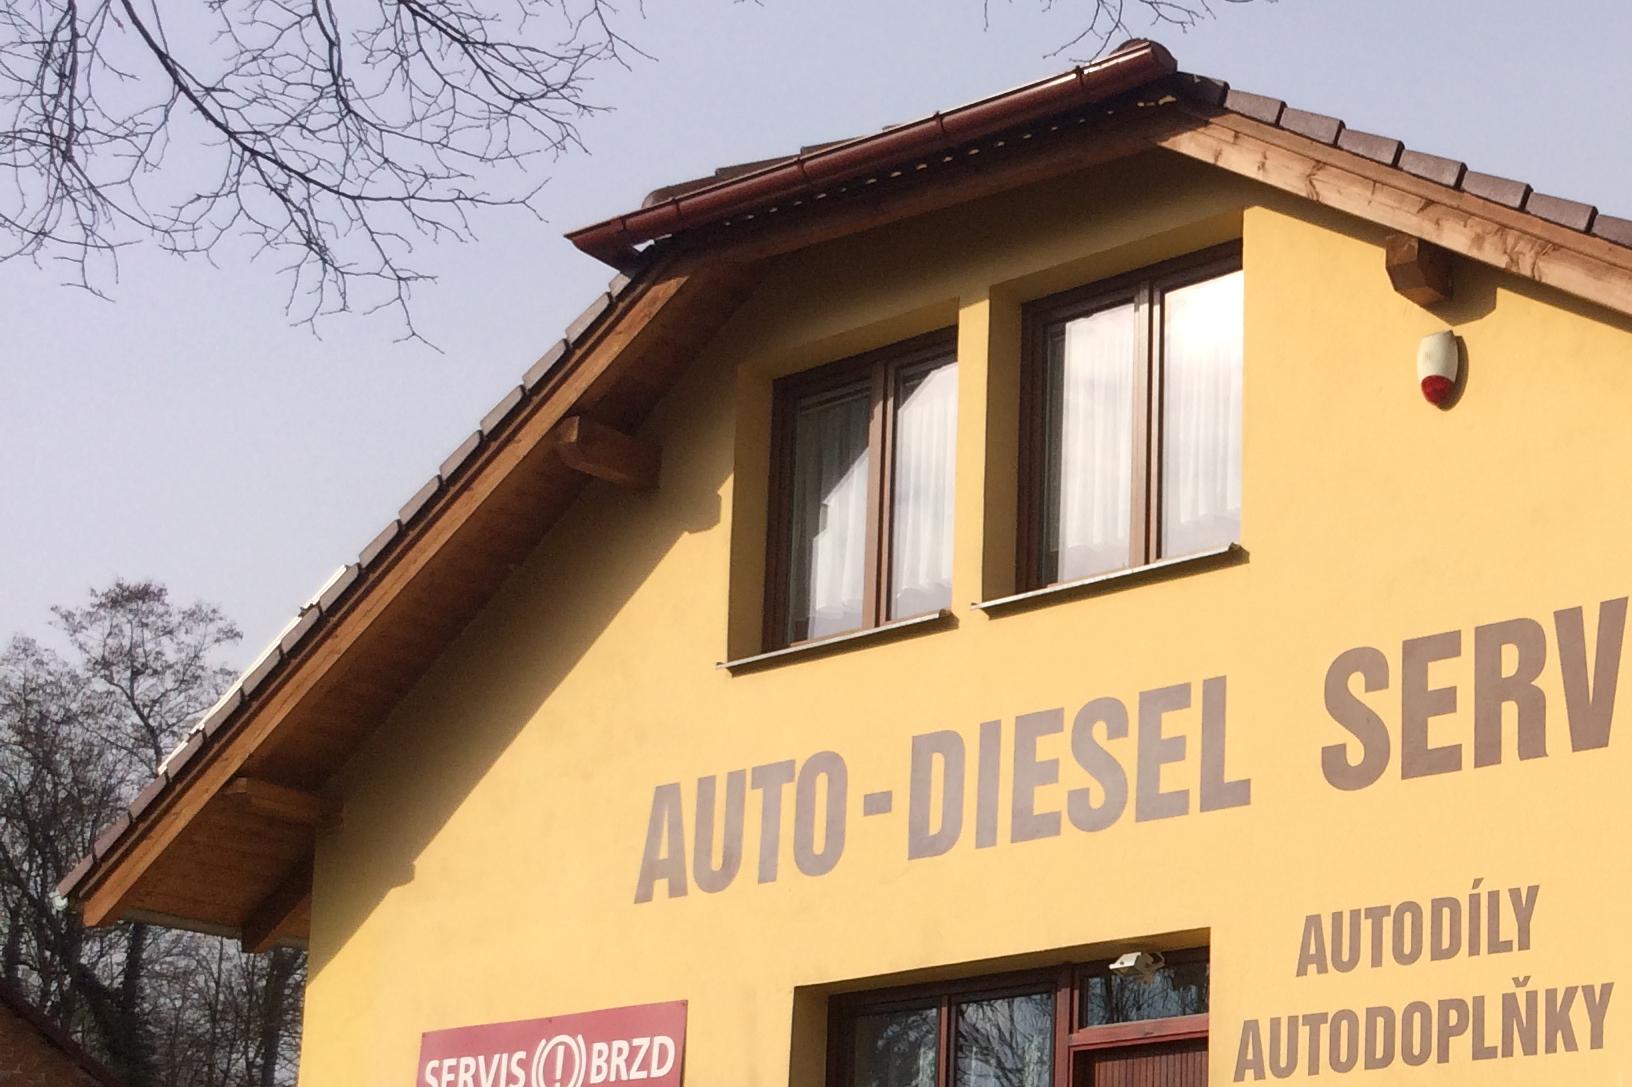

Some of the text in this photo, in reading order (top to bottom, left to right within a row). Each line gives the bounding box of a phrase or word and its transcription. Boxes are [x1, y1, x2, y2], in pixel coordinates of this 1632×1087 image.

[1295, 878, 1540, 977] AUTODÍLY
[590, 1035, 676, 1085] BRZD
[1233, 976, 1615, 1083] AUTODOPLŇKY
